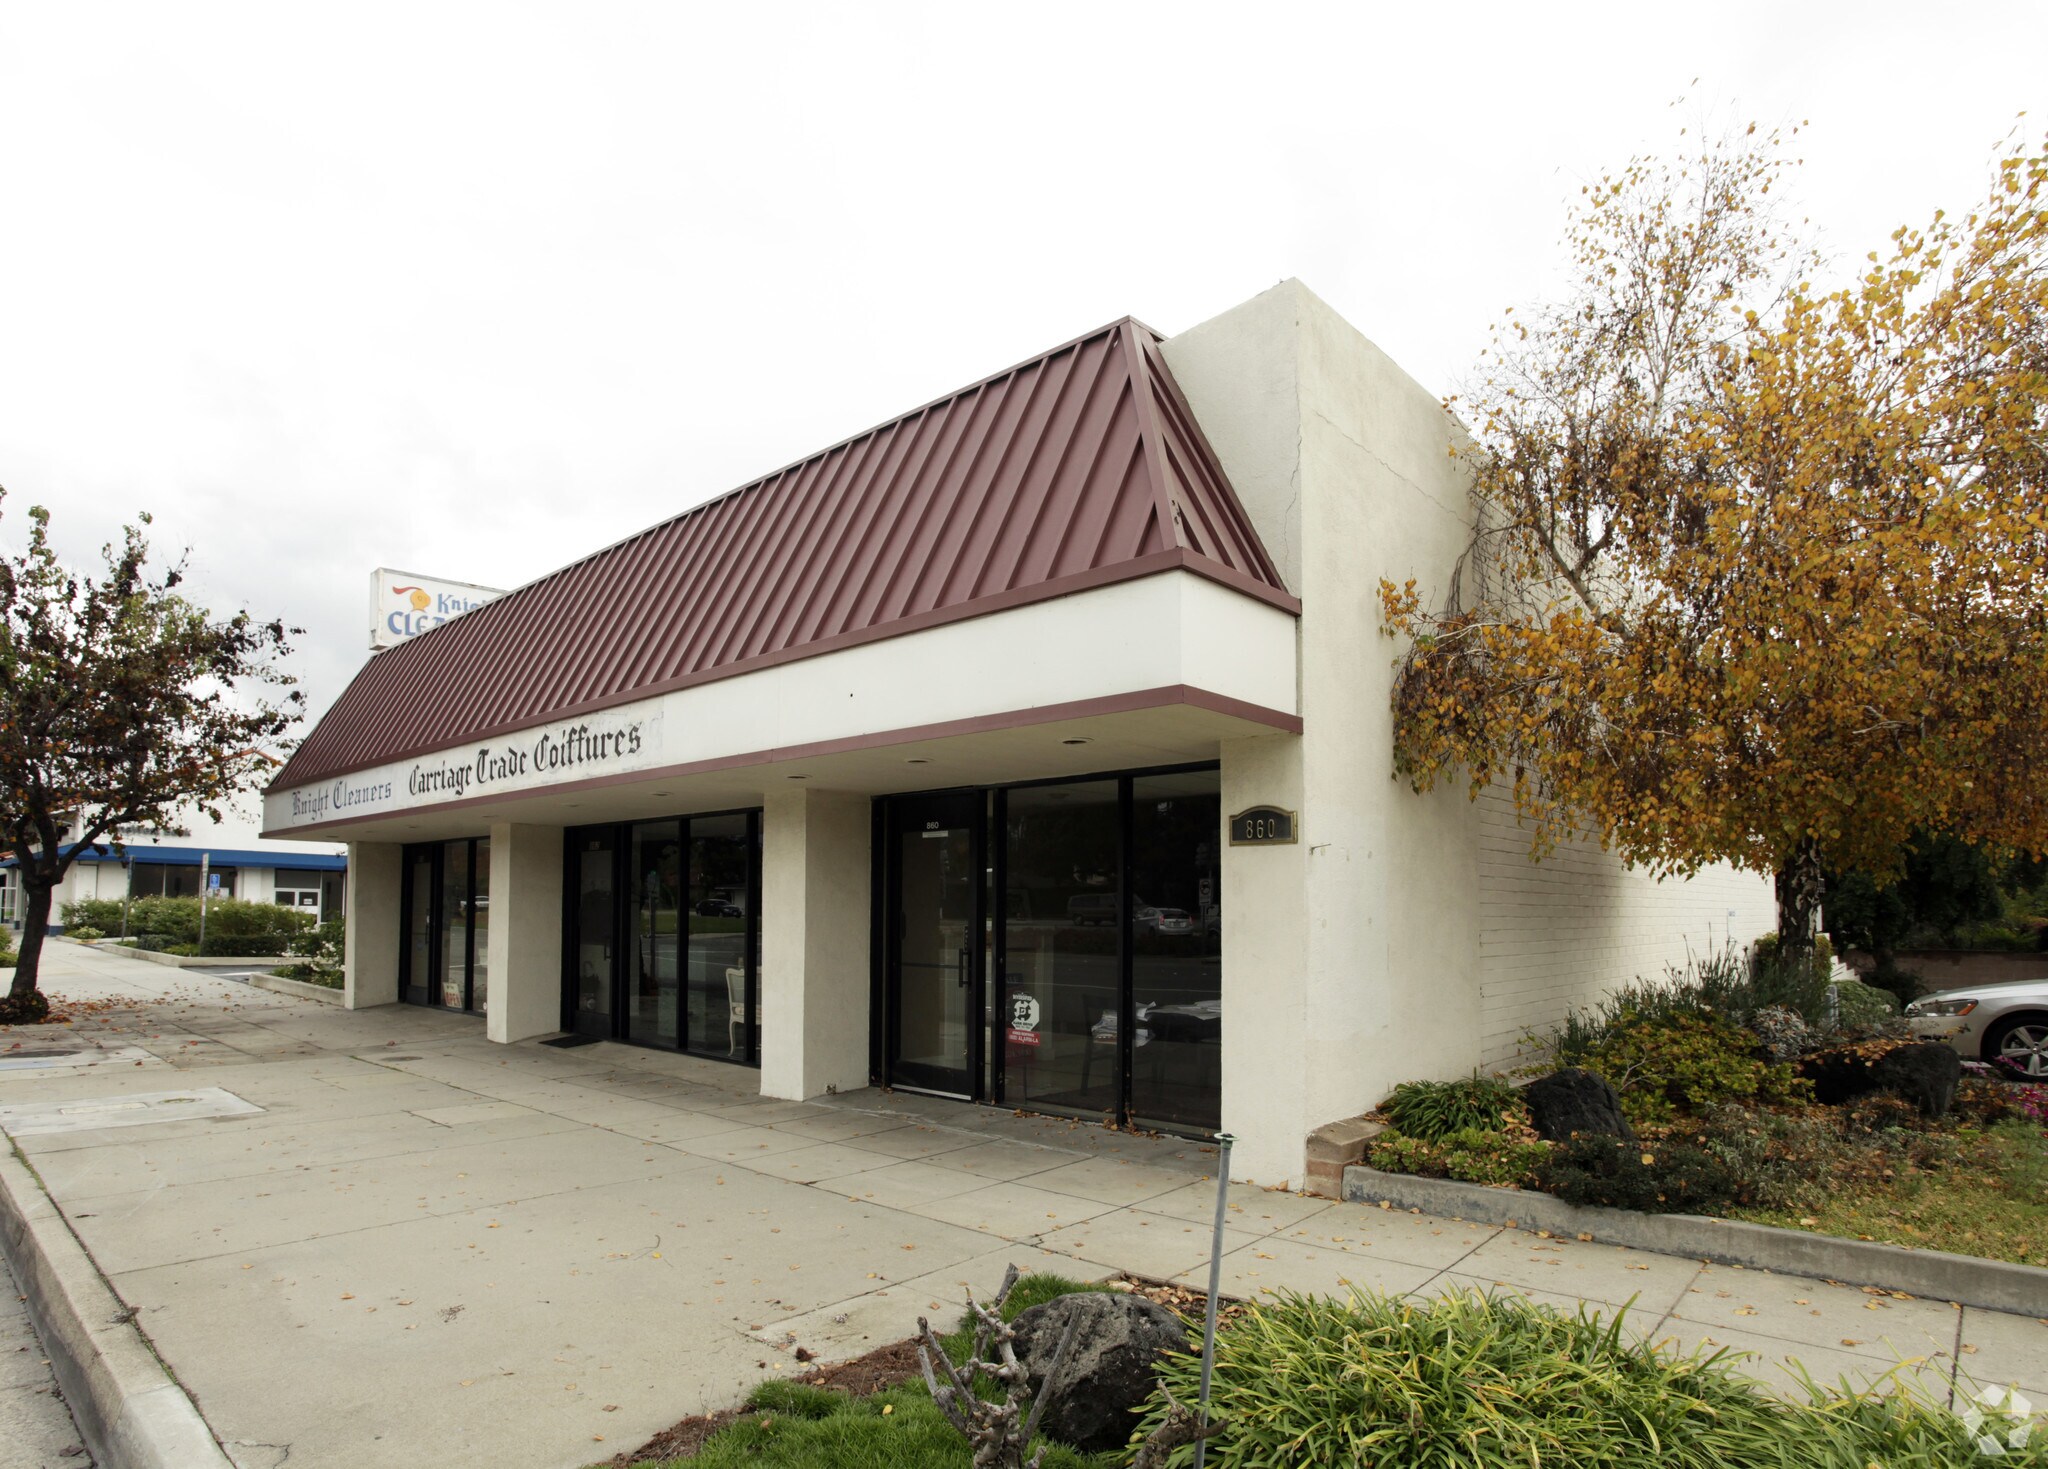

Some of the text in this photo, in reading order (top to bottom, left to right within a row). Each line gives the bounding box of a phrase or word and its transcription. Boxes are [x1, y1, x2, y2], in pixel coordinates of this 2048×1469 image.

[409, 722, 643, 796] Carriage Trade Coiffures
[292, 780, 392, 824] Knight Cleaners
[926, 821, 940, 829] 860
[1246, 819, 1275, 839] 860
